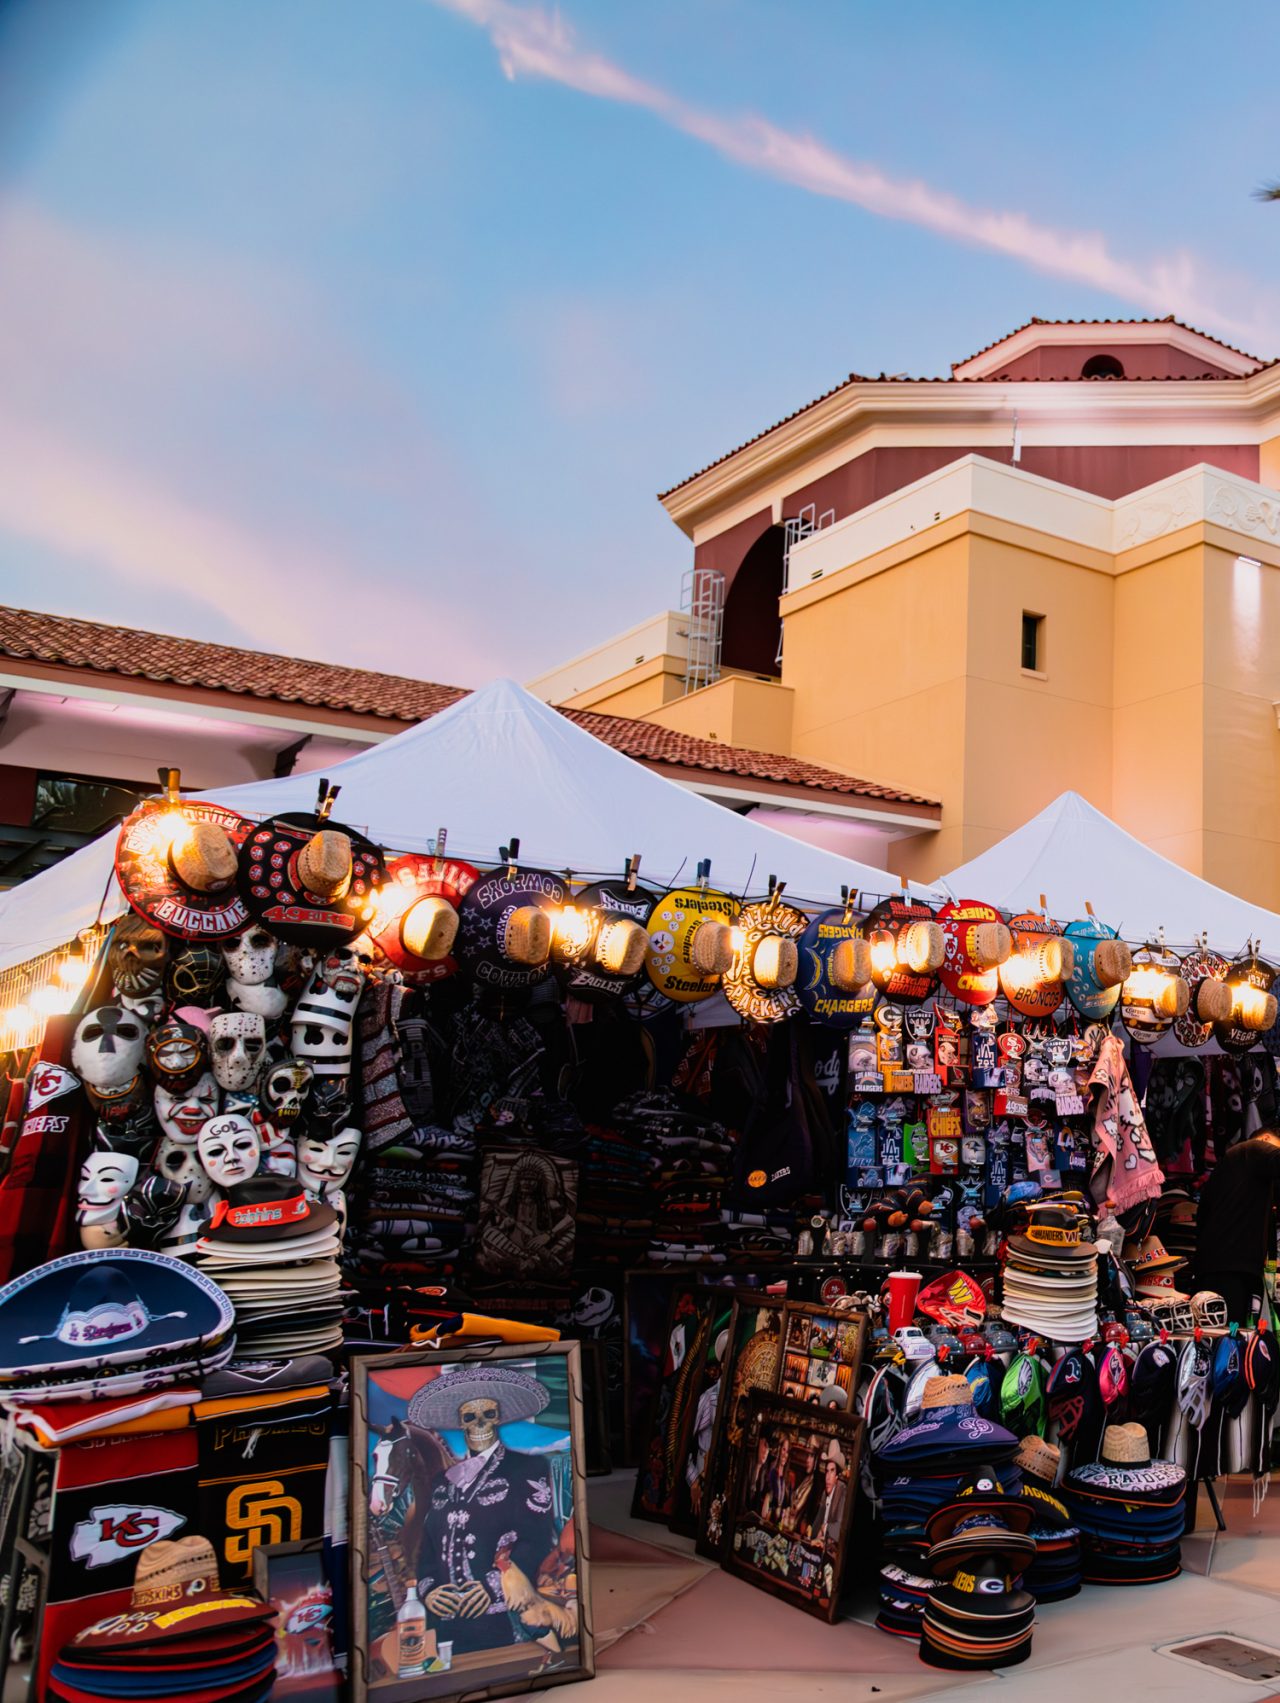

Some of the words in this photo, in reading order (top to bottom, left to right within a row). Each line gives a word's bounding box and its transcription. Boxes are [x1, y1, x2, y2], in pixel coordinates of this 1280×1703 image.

[477, 872, 565, 909] COWBOYS
[600, 893, 650, 920] EAGLES
[674, 897, 733, 916] Steelers
[950, 906, 996, 921] CHIEFS
[682, 919, 703, 964] Steelers
[568, 970, 625, 995] EAGLES
[664, 975, 721, 995] Steelers
[887, 982, 928, 998] BROWNS
[732, 984, 796, 1017] PACKERS
[1014, 986, 1063, 1006] BRONCOS
[814, 997, 874, 1016] CHARGERS
[1230, 1027, 1258, 1041] VEGAS
[209, 1121, 239, 1136] GOD
[931, 1117, 960, 1136] CHIEFS
[99, 1512, 160, 1548] KC
